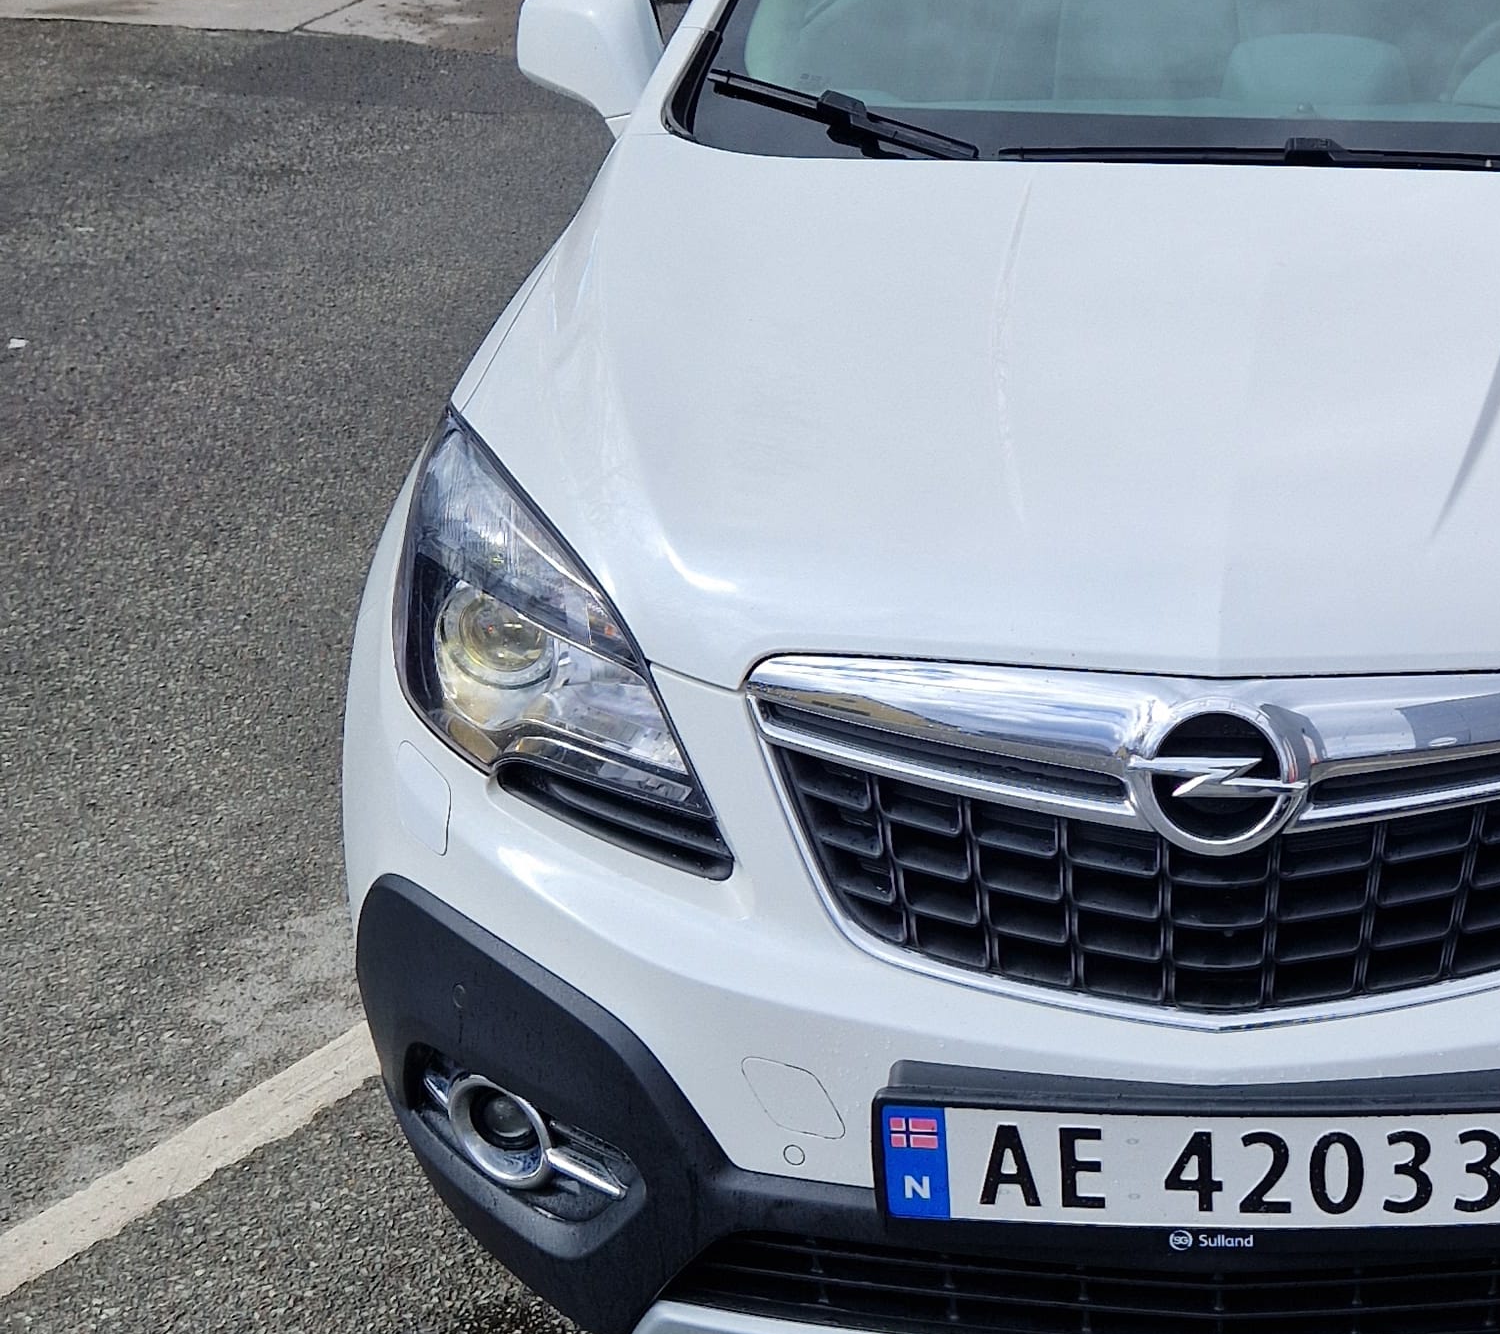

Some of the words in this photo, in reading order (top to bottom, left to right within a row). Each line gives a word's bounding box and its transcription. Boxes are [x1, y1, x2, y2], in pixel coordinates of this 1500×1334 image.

[979, 1124, 1106, 1209] AE
[904, 1175, 931, 1199] N
[1198, 1234, 1254, 1247] Sulland
